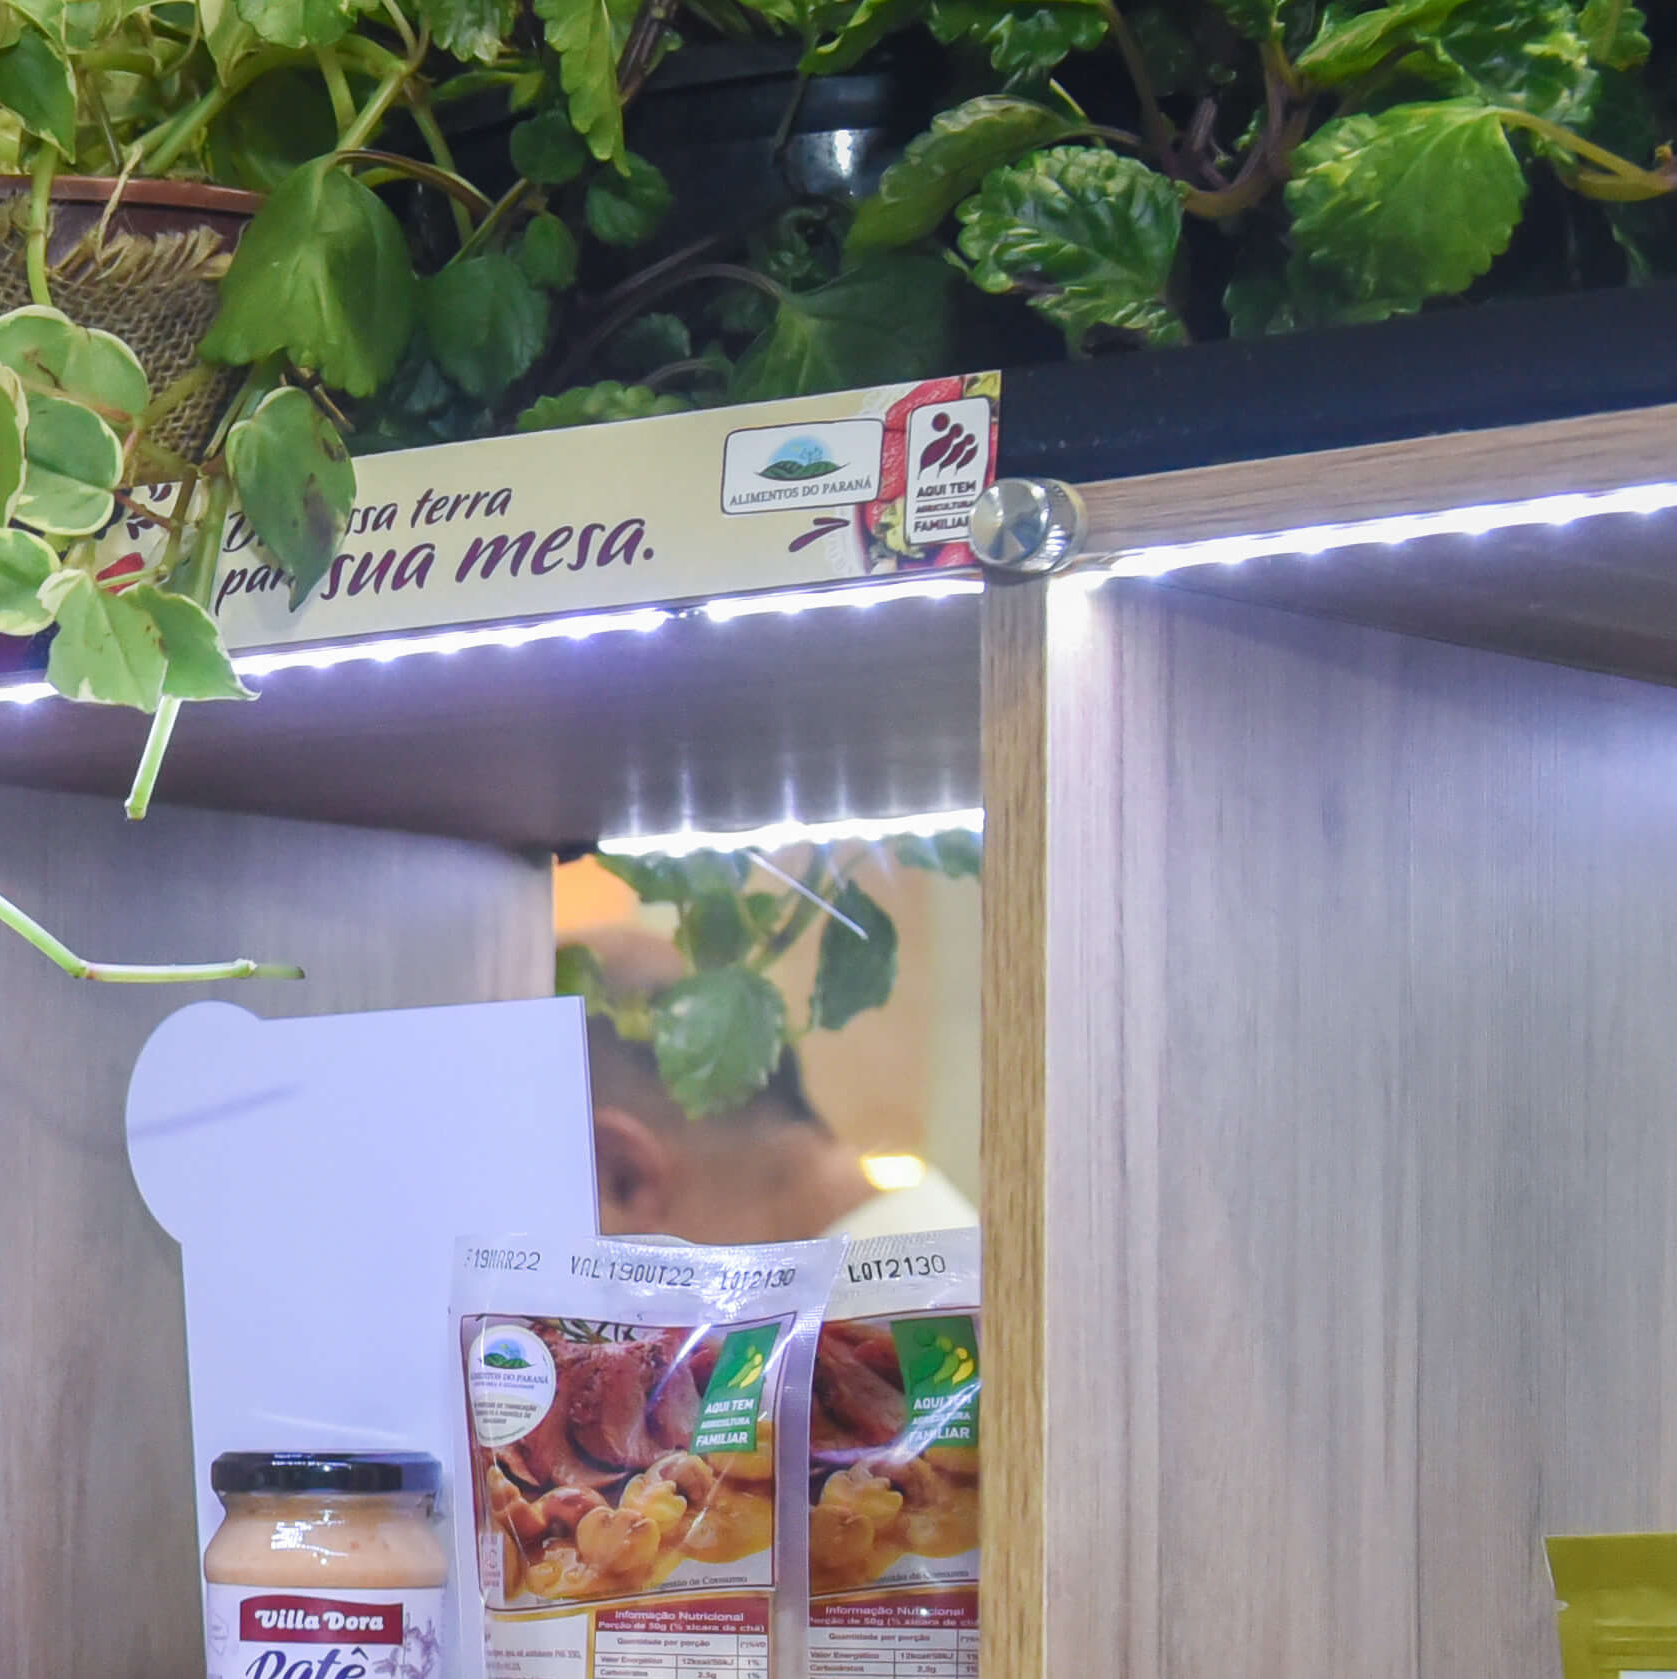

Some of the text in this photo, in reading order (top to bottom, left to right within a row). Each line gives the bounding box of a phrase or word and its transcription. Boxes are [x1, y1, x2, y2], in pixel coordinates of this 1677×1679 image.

[729, 475, 873, 506] ALIMENTOS DO PARANÁ
[916, 480, 977, 498] AQUI TEM
[410, 487, 514, 528] terra
[214, 516, 655, 617] par sua mesa.
[705, 1398, 754, 1414] AQUI TEM
[695, 1431, 748, 1446] FAMILIAR
[254, 1609, 384, 1631] Villa Dora
[615, 1610, 744, 1622] Informação Nutricional
[825, 1606, 965, 1617] Informação Nutcional
[633, 1621, 645, 1630] de
